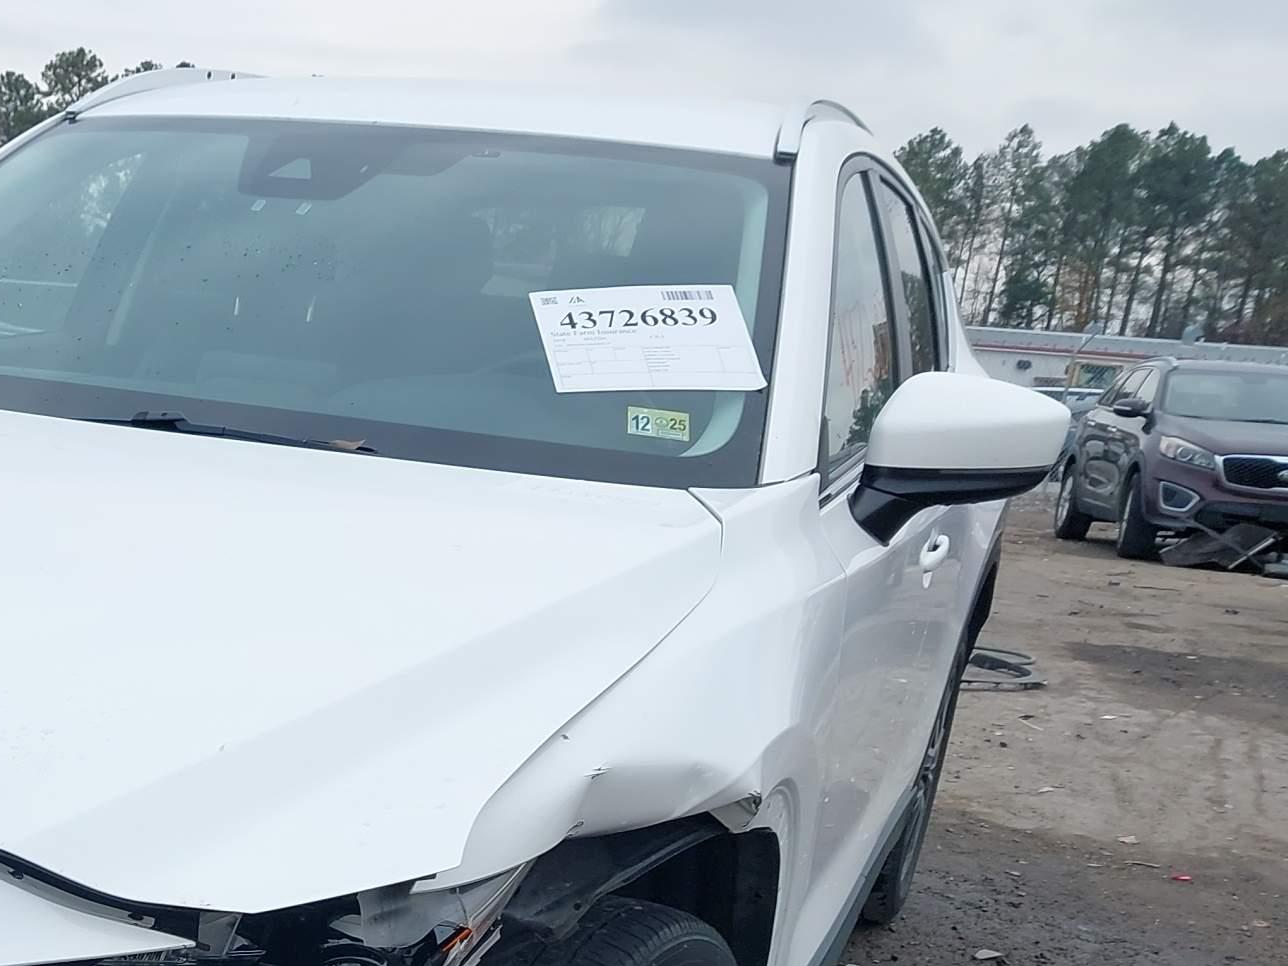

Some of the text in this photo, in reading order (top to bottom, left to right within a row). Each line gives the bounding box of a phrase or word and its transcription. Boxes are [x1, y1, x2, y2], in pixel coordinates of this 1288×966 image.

[560, 307, 718, 329] 43726839
[632, 415, 686, 432] 12 25
